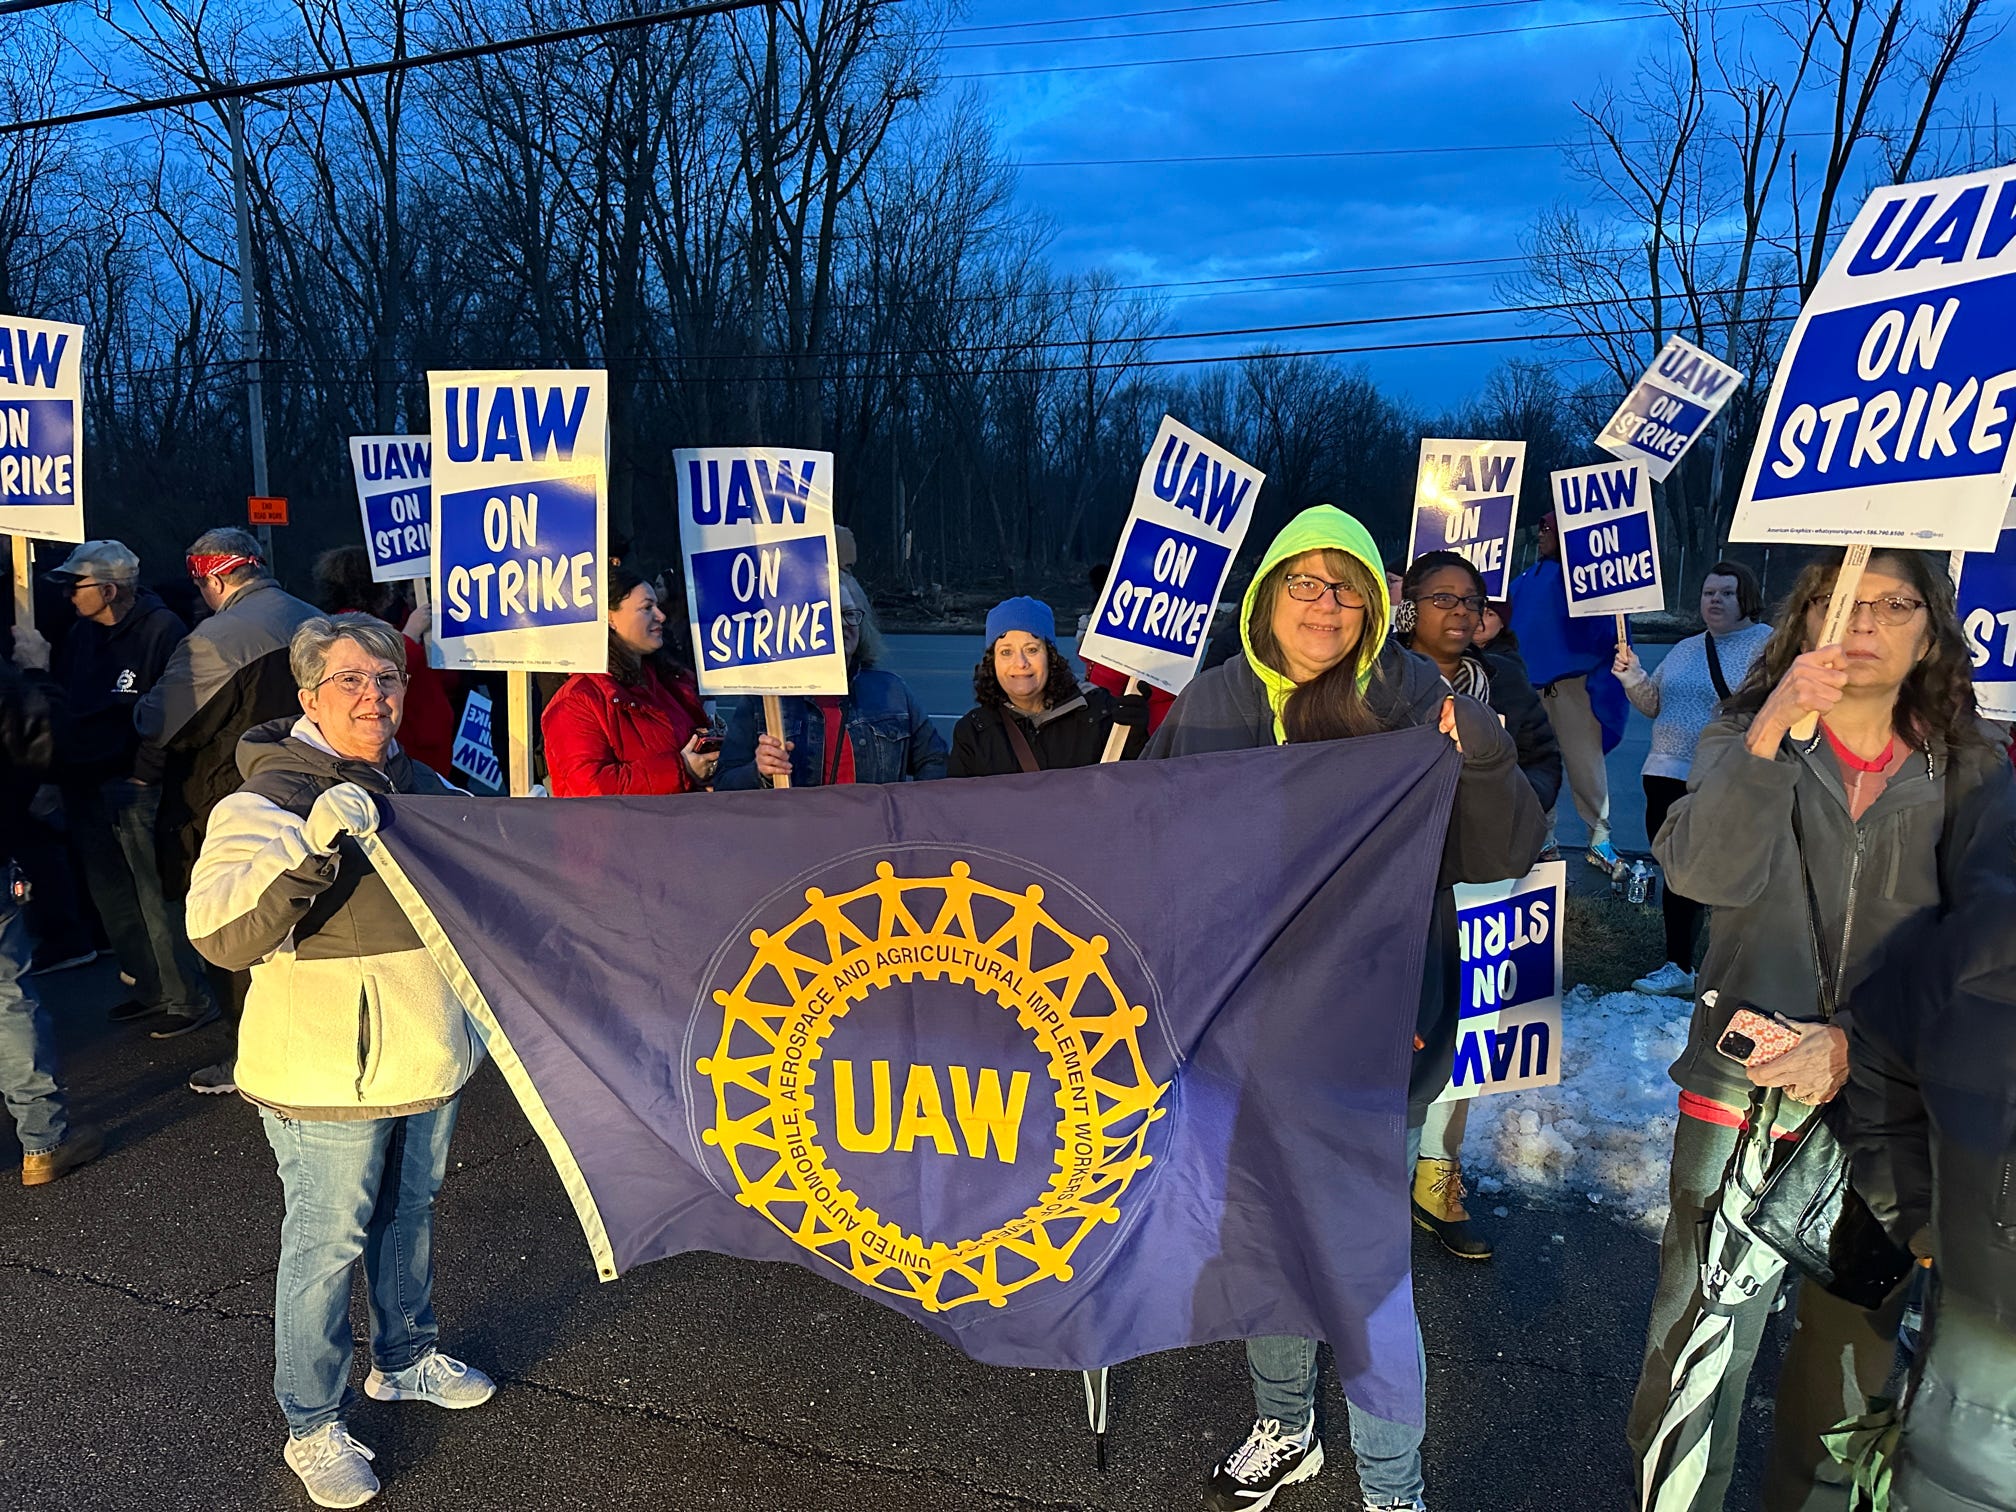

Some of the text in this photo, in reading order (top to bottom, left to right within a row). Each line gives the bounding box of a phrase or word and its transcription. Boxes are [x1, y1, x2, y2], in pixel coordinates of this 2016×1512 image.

[0, 326, 69, 389] AW
[1857, 297, 1960, 382] ON
[1658, 344, 1733, 401] UAW
[445, 386, 591, 463] UAW
[1615, 411, 1689, 457] STRIKE
[1649, 395, 1684, 424] ON
[1771, 369, 2016, 479] STRIKE
[0, 454, 73, 496] RIKE
[361, 442, 431, 481] UAW
[1153, 433, 1252, 534] UAW
[390, 493, 421, 524] ON
[688, 459, 816, 526] UAW
[1560, 466, 1638, 516] UAW
[375, 522, 431, 559] STRI
[483, 492, 539, 553] ON
[1444, 506, 1482, 544] ON
[1588, 525, 1620, 558] ON
[447, 551, 594, 622] STRIKE
[731, 547, 781, 603] ON
[1153, 537, 1198, 589] ON
[1572, 549, 1653, 594] STRIKE
[708, 600, 830, 663] STRIKE
[1107, 579, 1209, 645] STRIKE
[1458, 900, 1550, 962] STRI
[833, 959, 870, 992] AND
[876, 944, 1024, 996] AGRICULTURAL
[1472, 959, 1518, 1008] ON
[781, 987, 835, 1101] AEROSPACE
[1026, 990, 1090, 1116] IMPLEMENT
[832, 1059, 1031, 1165] UAW
[783, 1107, 861, 1232] AUTOMOBILE,
[1057, 1122, 1093, 1201] WORKERS
[1041, 1203, 1063, 1217] OF
[861, 1230, 932, 1270] UNITED
